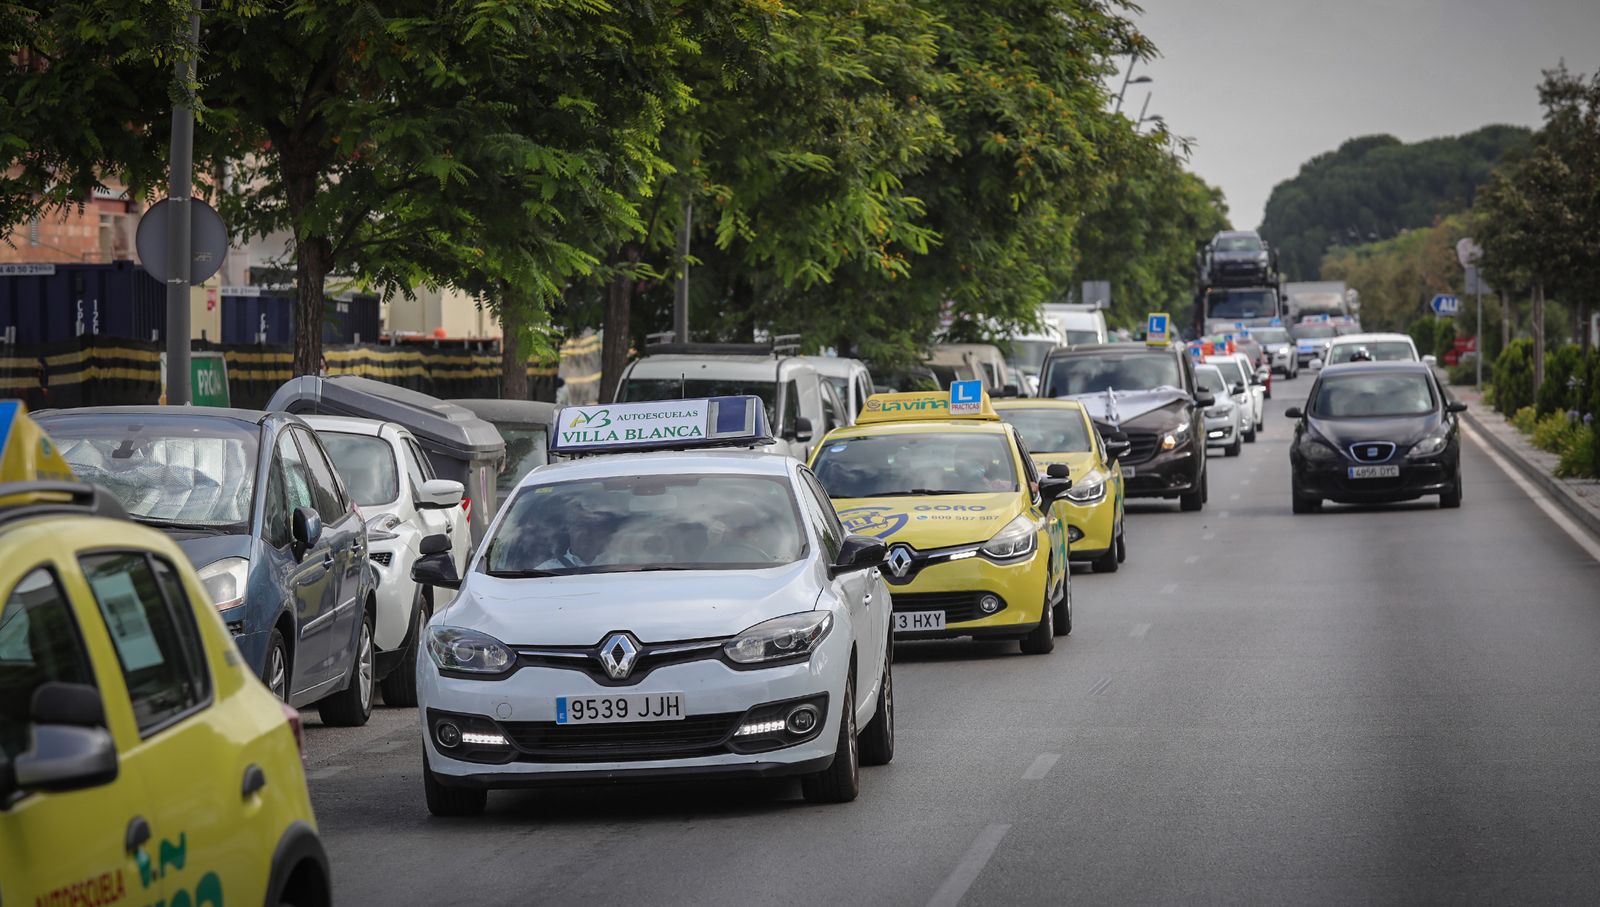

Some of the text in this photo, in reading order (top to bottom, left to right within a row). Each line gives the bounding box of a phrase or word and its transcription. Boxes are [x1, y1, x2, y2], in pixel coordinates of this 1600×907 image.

[1152, 318, 1162, 331] L
[958, 384, 973, 400] L
[616, 410, 699, 421] AUTOESCUELAS
[562, 425, 703, 443] VILLA BLANCA
[913, 504, 987, 512] GORO
[913, 613, 941, 628] HXY
[571, 698, 628, 720] 9539
[638, 696, 680, 717] JJH
